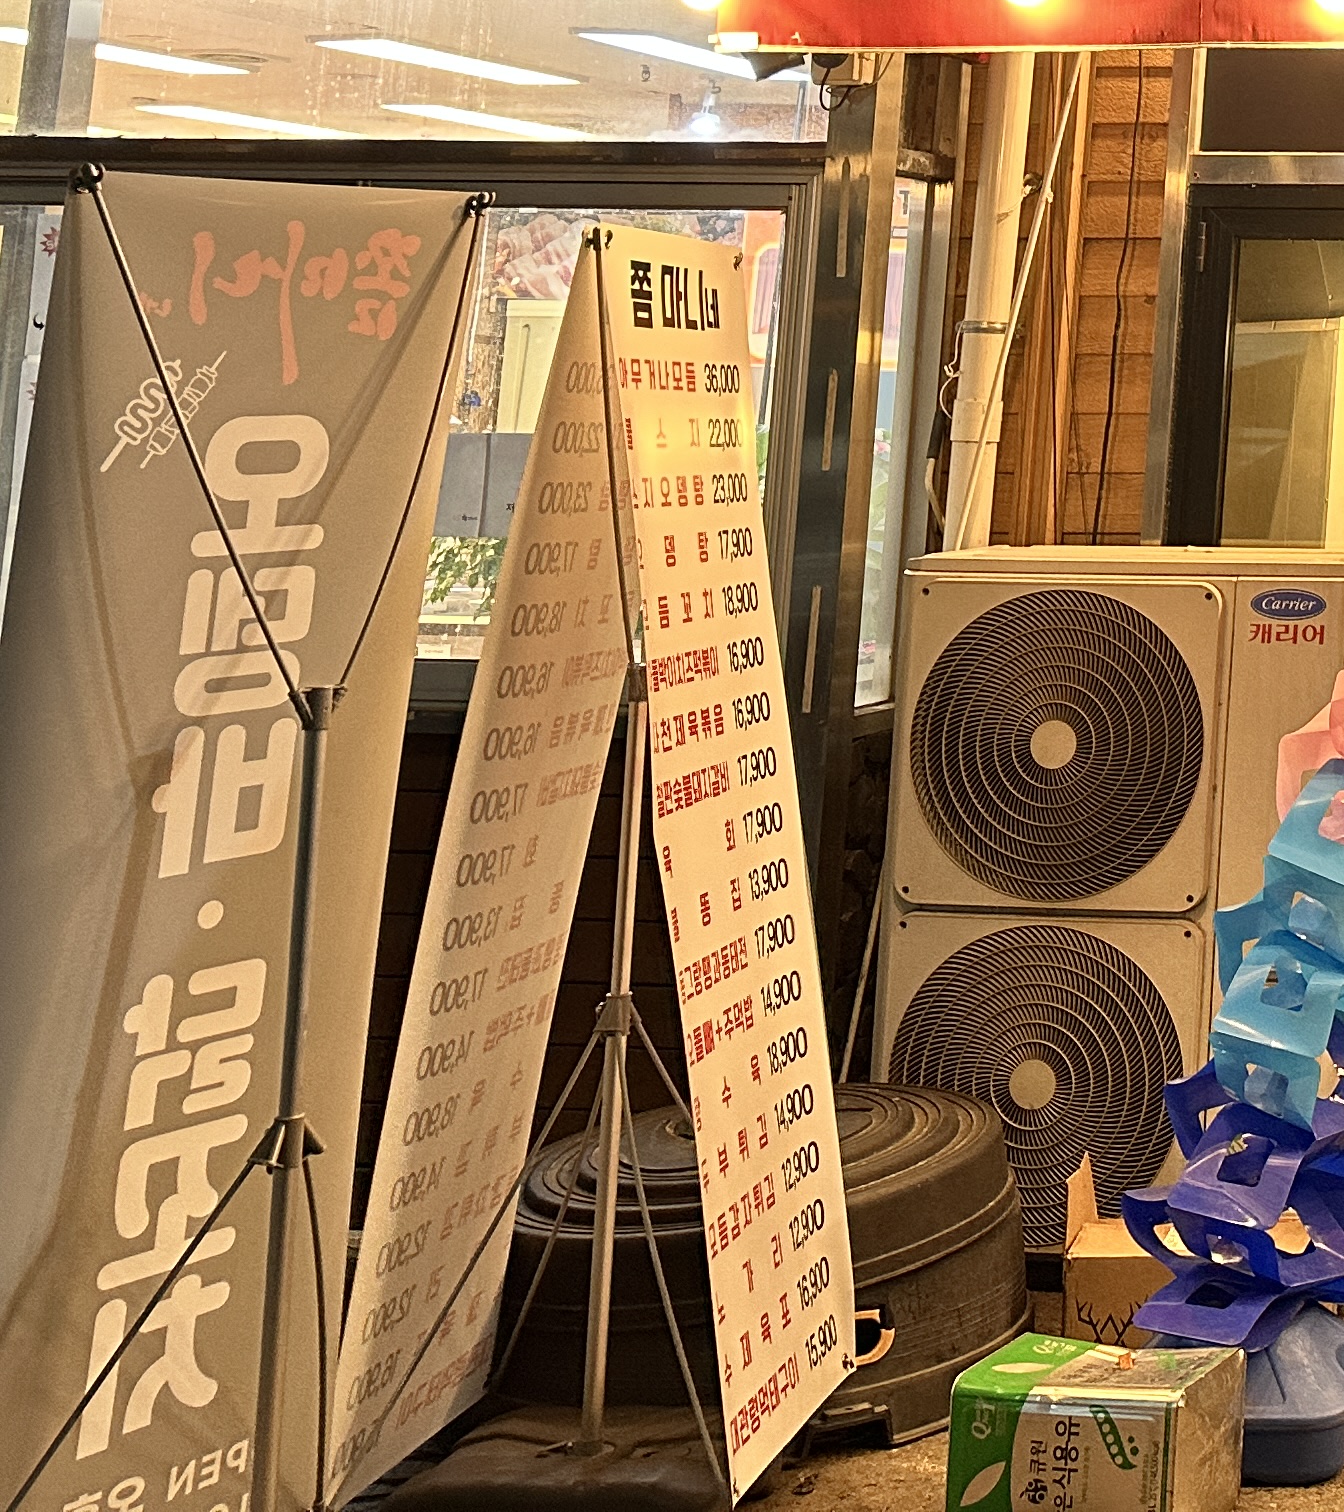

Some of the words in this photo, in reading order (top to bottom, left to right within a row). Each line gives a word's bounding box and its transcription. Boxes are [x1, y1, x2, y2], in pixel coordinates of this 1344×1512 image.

[704, 365, 740, 397] 36,000
[712, 474, 747, 508] 23,000
[717, 527, 754, 563] 17,900
[721, 582, 758, 617] 18,900
[1261, 595, 1317, 613] Carrier
[1248, 623, 1325, 645] 캐리어
[727, 636, 764, 679] 16,900
[732, 691, 771, 731] 16,900
[737, 746, 777, 787] 17,900
[743, 802, 783, 845] 17,900
[748, 858, 789, 901] 13,900
[754, 914, 795, 959] 17,900
[761, 970, 802, 1018] 14,900
[766, 1026, 808, 1077] 18,900
[774, 1083, 813, 1133] 14,900
[781, 1141, 820, 1192] 12,900
[788, 1198, 825, 1252] 12,900
[796, 1256, 830, 1312] 16,900
[805, 1314, 837, 1370] 15,900
[1030, 1440, 1047, 1474] 큐원
[1052, 1416, 1080, 1512] 은식용유
